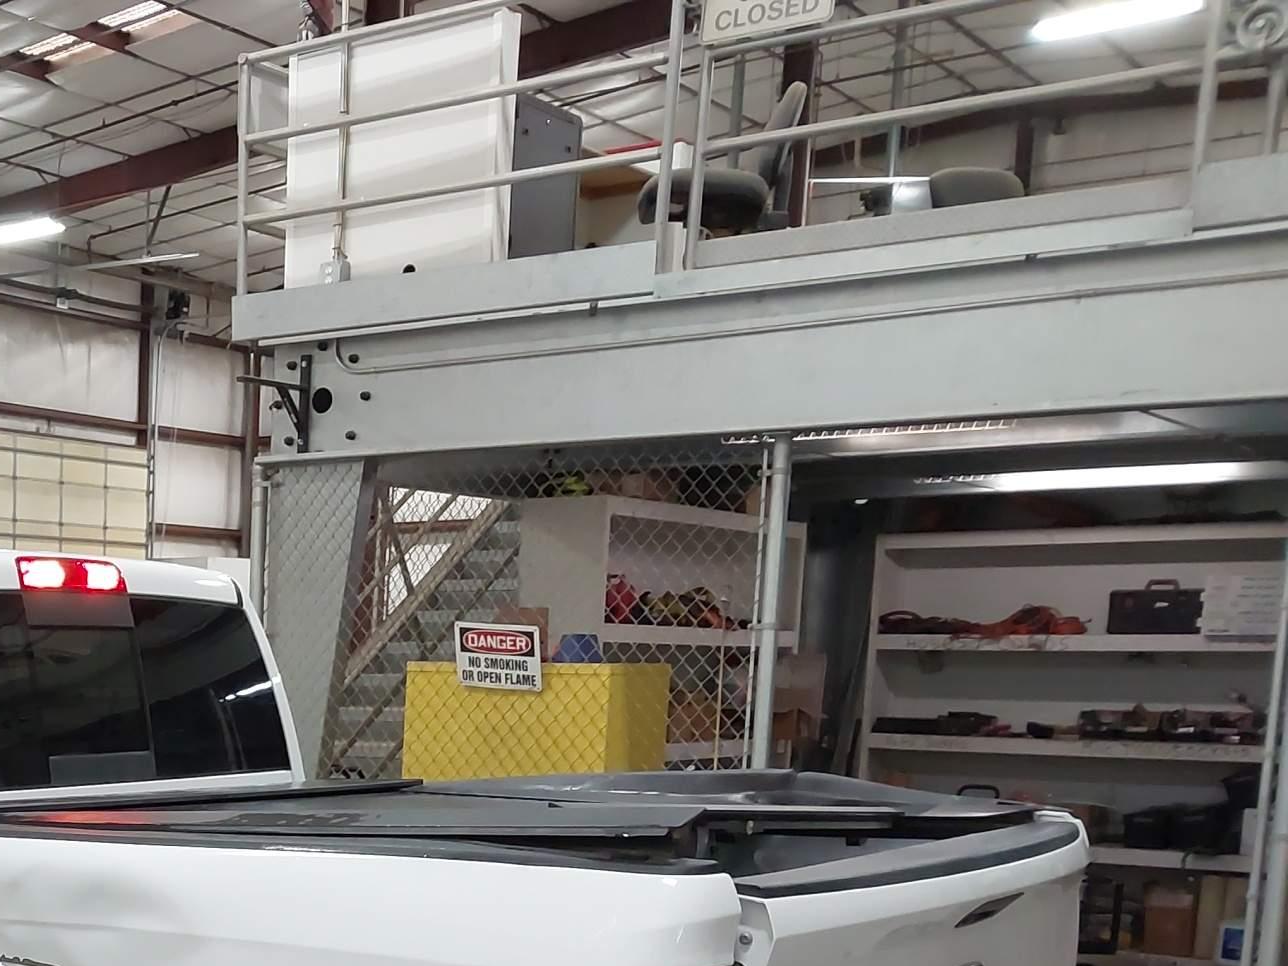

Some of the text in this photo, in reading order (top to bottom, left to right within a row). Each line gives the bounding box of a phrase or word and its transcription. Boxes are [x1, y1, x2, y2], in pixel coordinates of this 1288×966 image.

[715, 0, 818, 31] CLOSED
[467, 634, 526, 650] DANGER
[468, 656, 528, 671] NO SMOKING
[462, 670, 537, 687] OR OPEN FLAME
